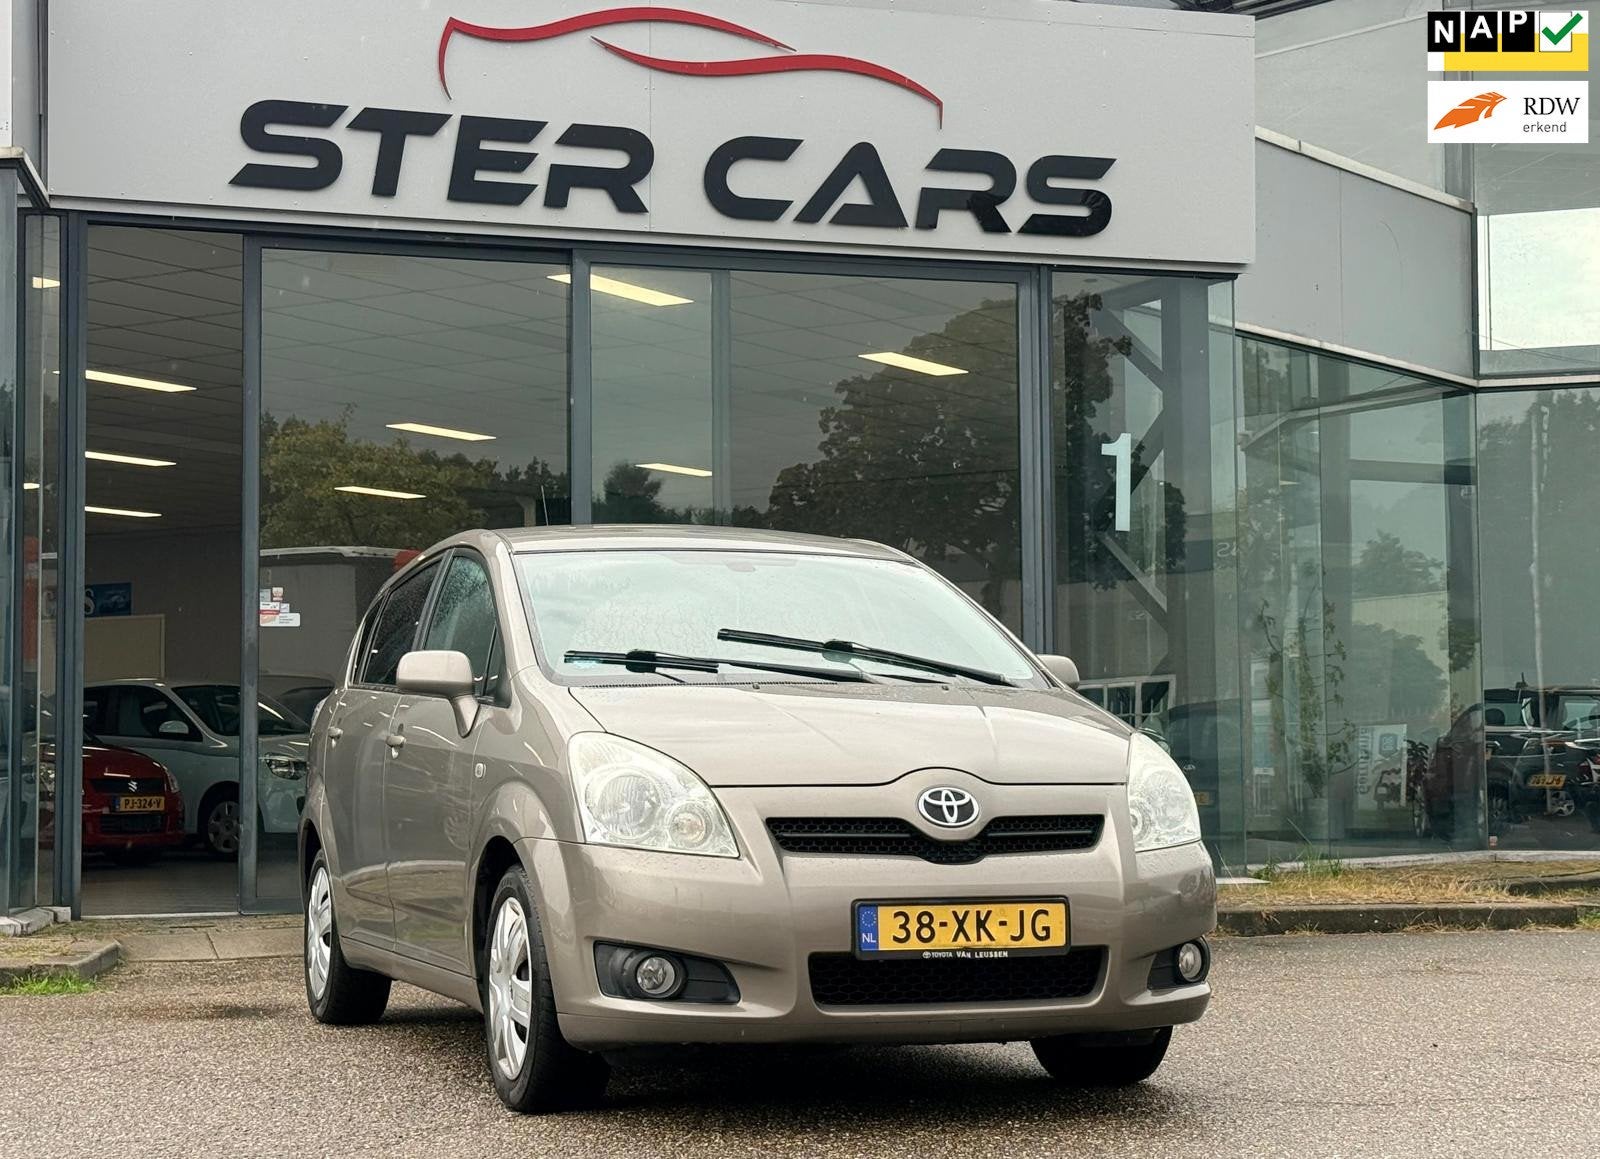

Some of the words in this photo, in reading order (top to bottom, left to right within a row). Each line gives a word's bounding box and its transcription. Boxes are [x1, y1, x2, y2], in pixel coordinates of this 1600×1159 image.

[228, 99, 655, 214] STER
[703, 135, 1118, 237] CARS
[1101, 432, 1132, 532] 1
[861, 932, 877, 944] NL
[892, 908, 1051, 944] 38-XK-JG
